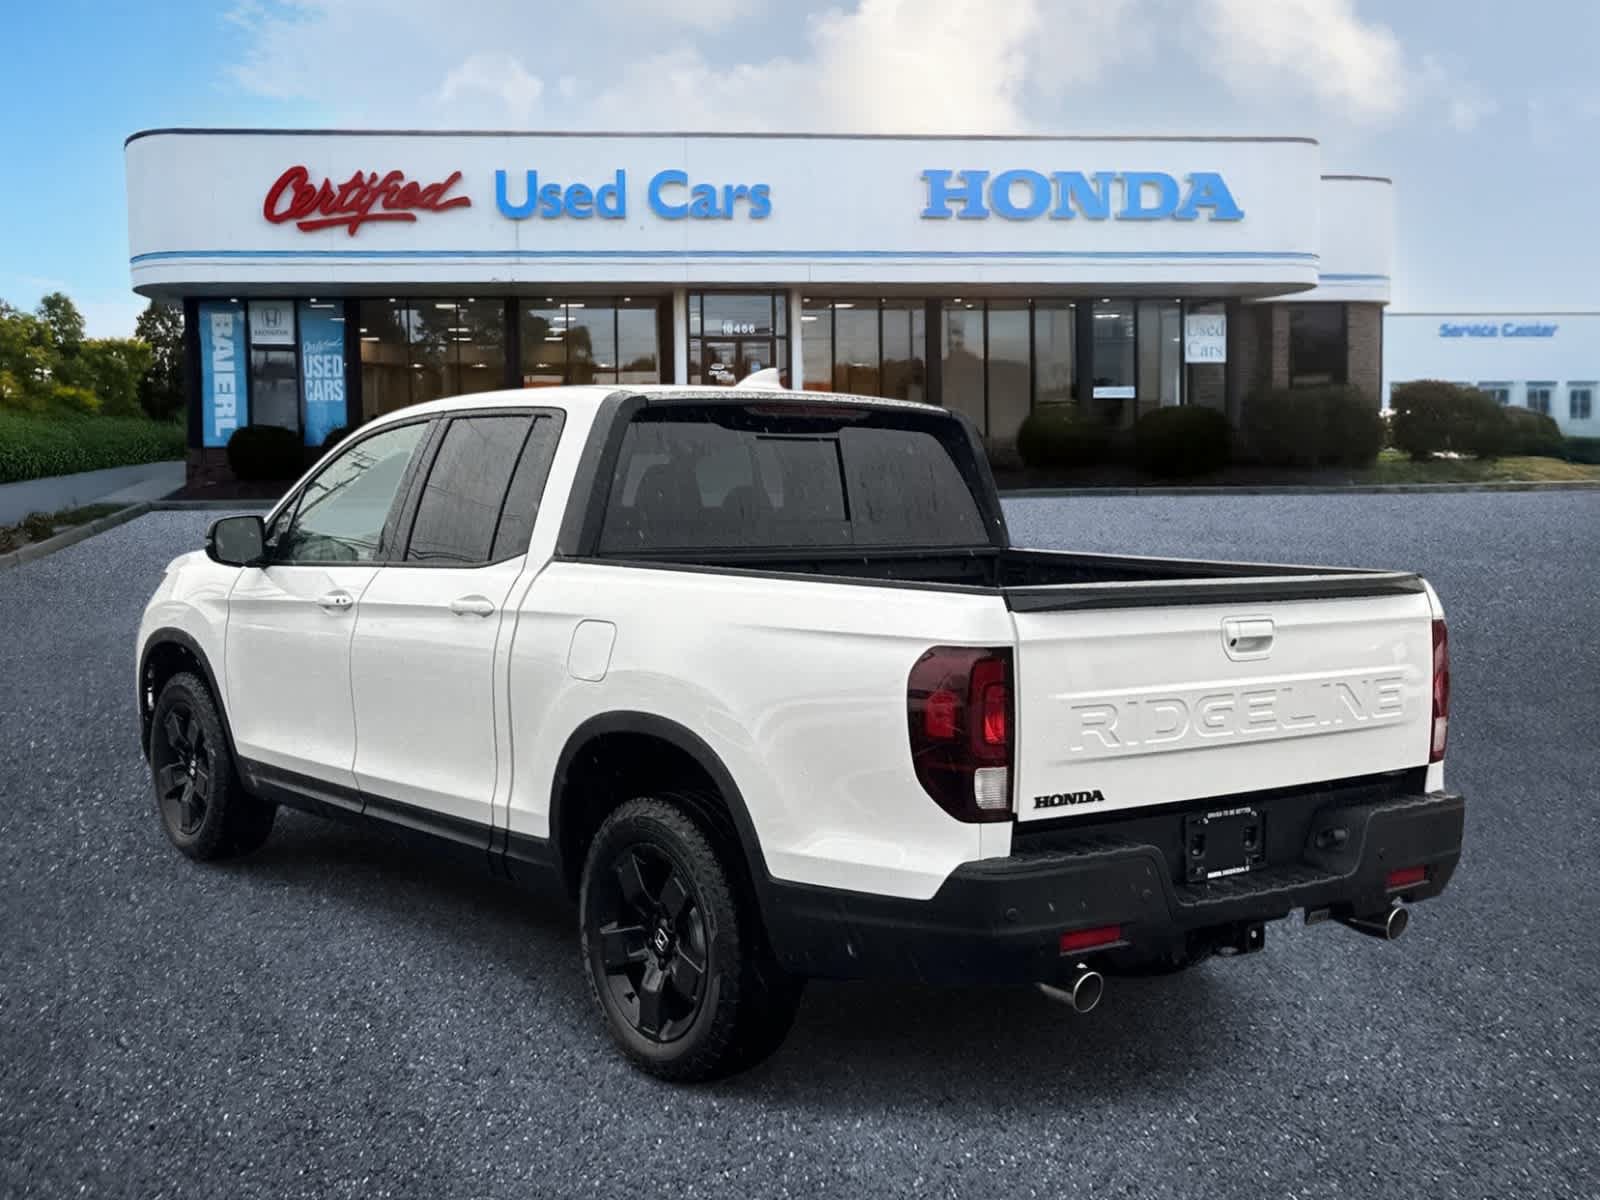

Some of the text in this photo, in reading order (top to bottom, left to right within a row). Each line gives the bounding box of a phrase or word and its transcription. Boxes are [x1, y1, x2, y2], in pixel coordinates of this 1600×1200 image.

[264, 165, 771, 237] Certified Used Cars
[920, 168, 1245, 221] HONDA
[1187, 319, 1225, 337] Used
[1439, 322, 1558, 338] Service Center
[1187, 341, 1223, 358] Cars
[211, 312, 237, 437] BAIERL
[303, 354, 343, 378] USED
[304, 379, 344, 402] CARS
[1070, 677, 1407, 752] RIDGELINE
[1033, 789, 1106, 809] HONDA
